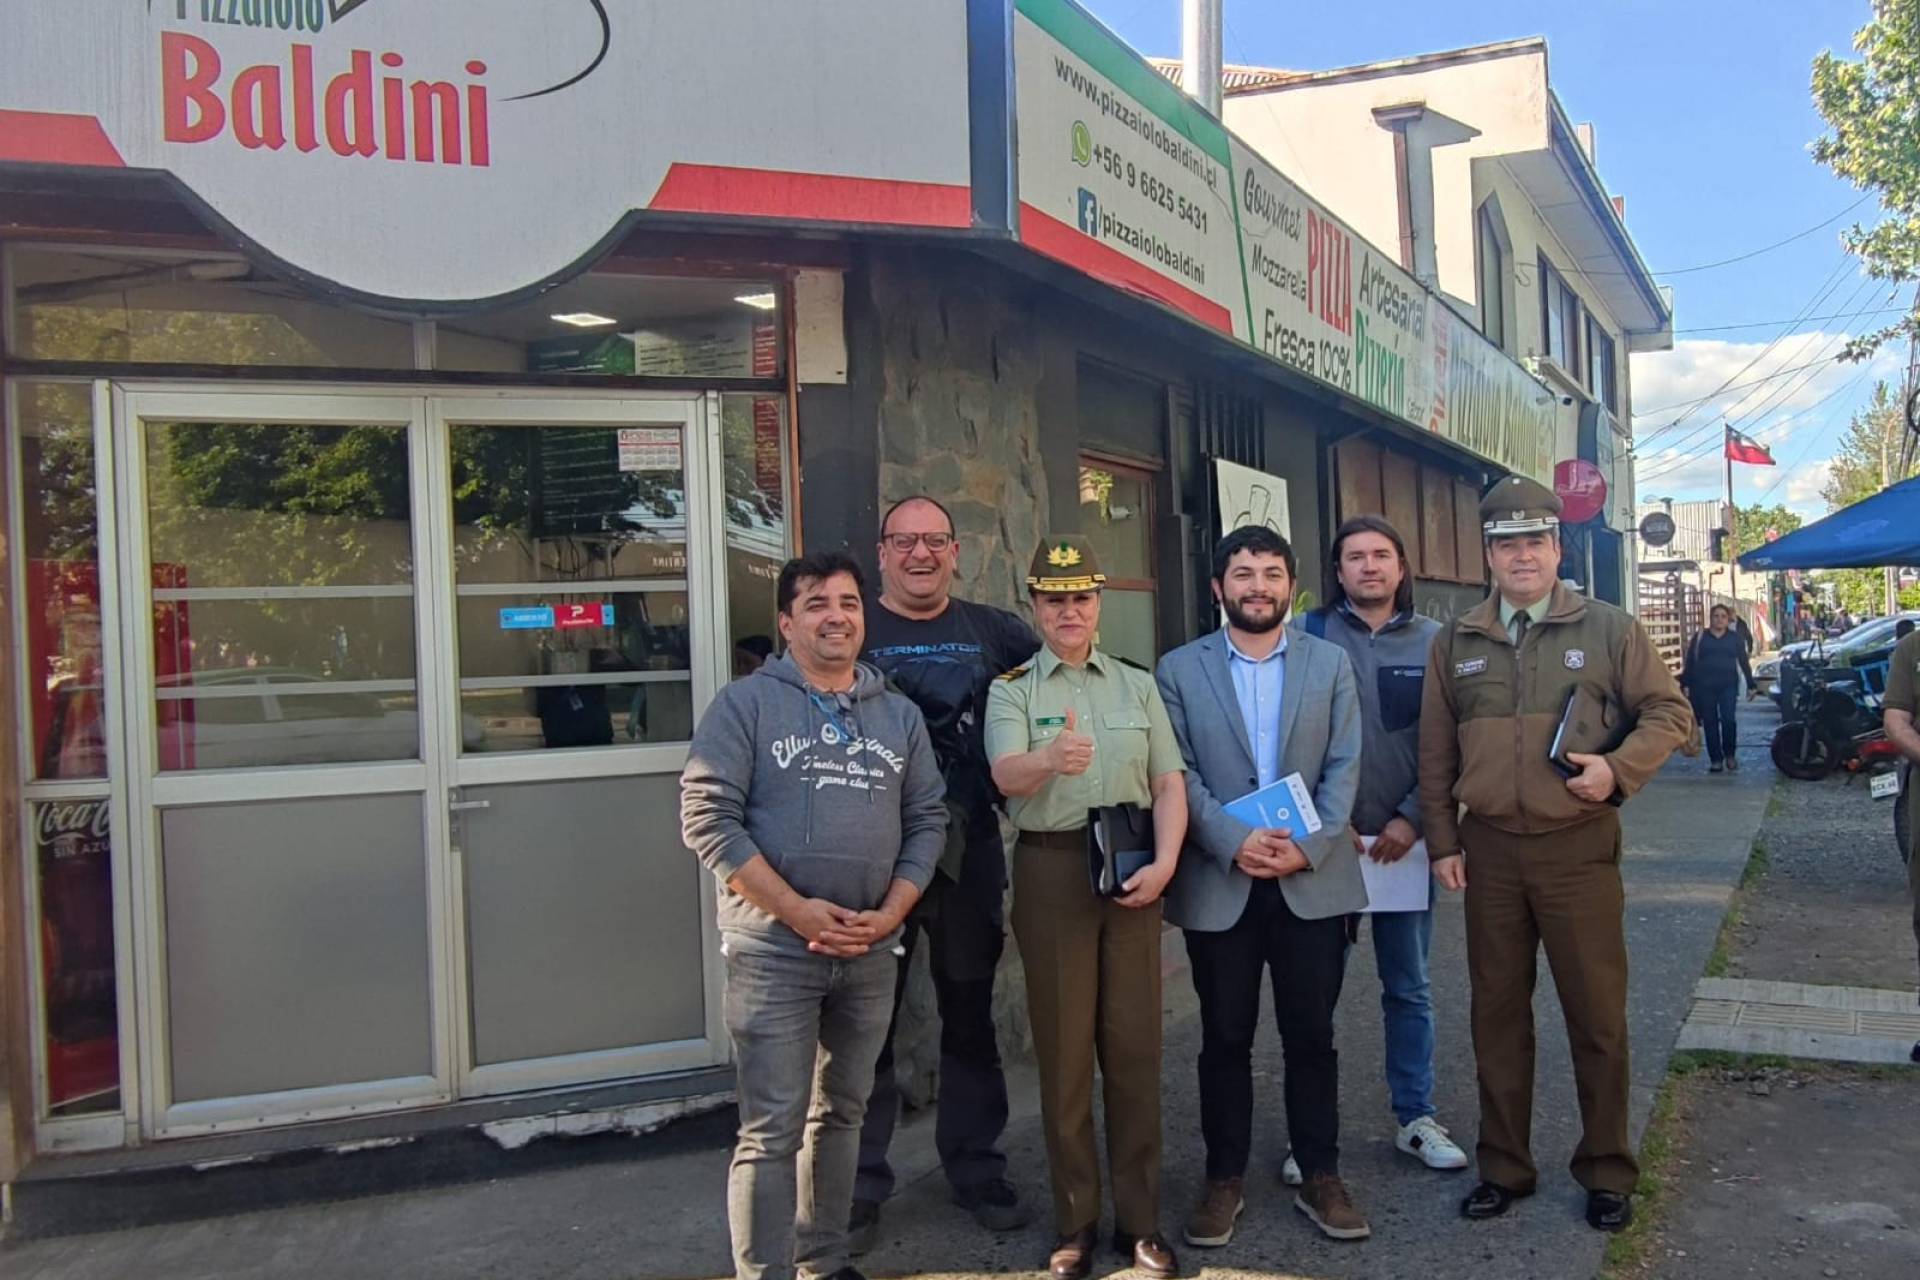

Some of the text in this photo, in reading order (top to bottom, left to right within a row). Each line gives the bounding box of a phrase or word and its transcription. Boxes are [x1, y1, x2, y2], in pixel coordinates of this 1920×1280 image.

[161, 31, 490, 167] Baldini
[1054, 56, 1217, 189] www.pizzaiolobaldini.cl
[1093, 143, 1207, 235] +56 9 6625 5431
[1244, 167, 1302, 242] Gourmet
[1099, 208, 1205, 286] /pizzaiolobaldini
[1307, 208, 1352, 337] PIZZA
[1359, 251, 1425, 343] Artesanal
[1264, 307, 1315, 377] Fresca
[1320, 338, 1352, 393] 100%
[868, 643, 981, 657] TERMINATOR
